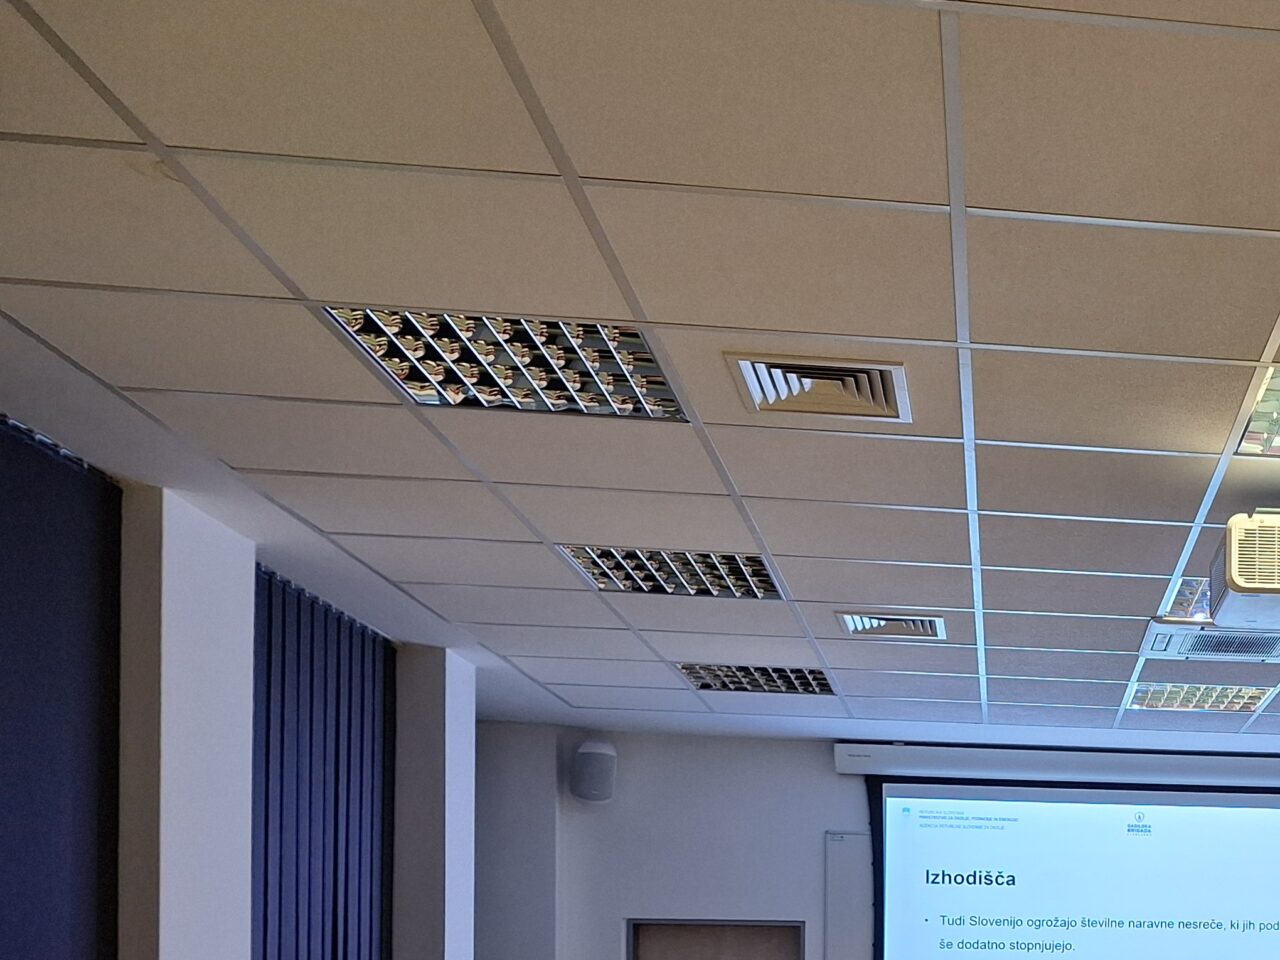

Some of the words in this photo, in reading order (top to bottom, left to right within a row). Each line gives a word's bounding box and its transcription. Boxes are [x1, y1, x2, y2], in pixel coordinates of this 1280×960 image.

[926, 869, 1016, 886] Izhodišča
[940, 915, 965, 926] Tudi
[969, 915, 1023, 929] Slovenijo
[1027, 916, 1077, 930] ogrožajo
[1081, 916, 1124, 928] številne
[1128, 920, 1174, 929] naravne
[1178, 919, 1226, 931] nesreče,
[1230, 920, 1239, 930] ki
[1242, 920, 1255, 933] jih
[939, 938, 953, 950] še
[957, 939, 1006, 950] dodatno
[1009, 940, 1075, 953] stopnjujejo.
